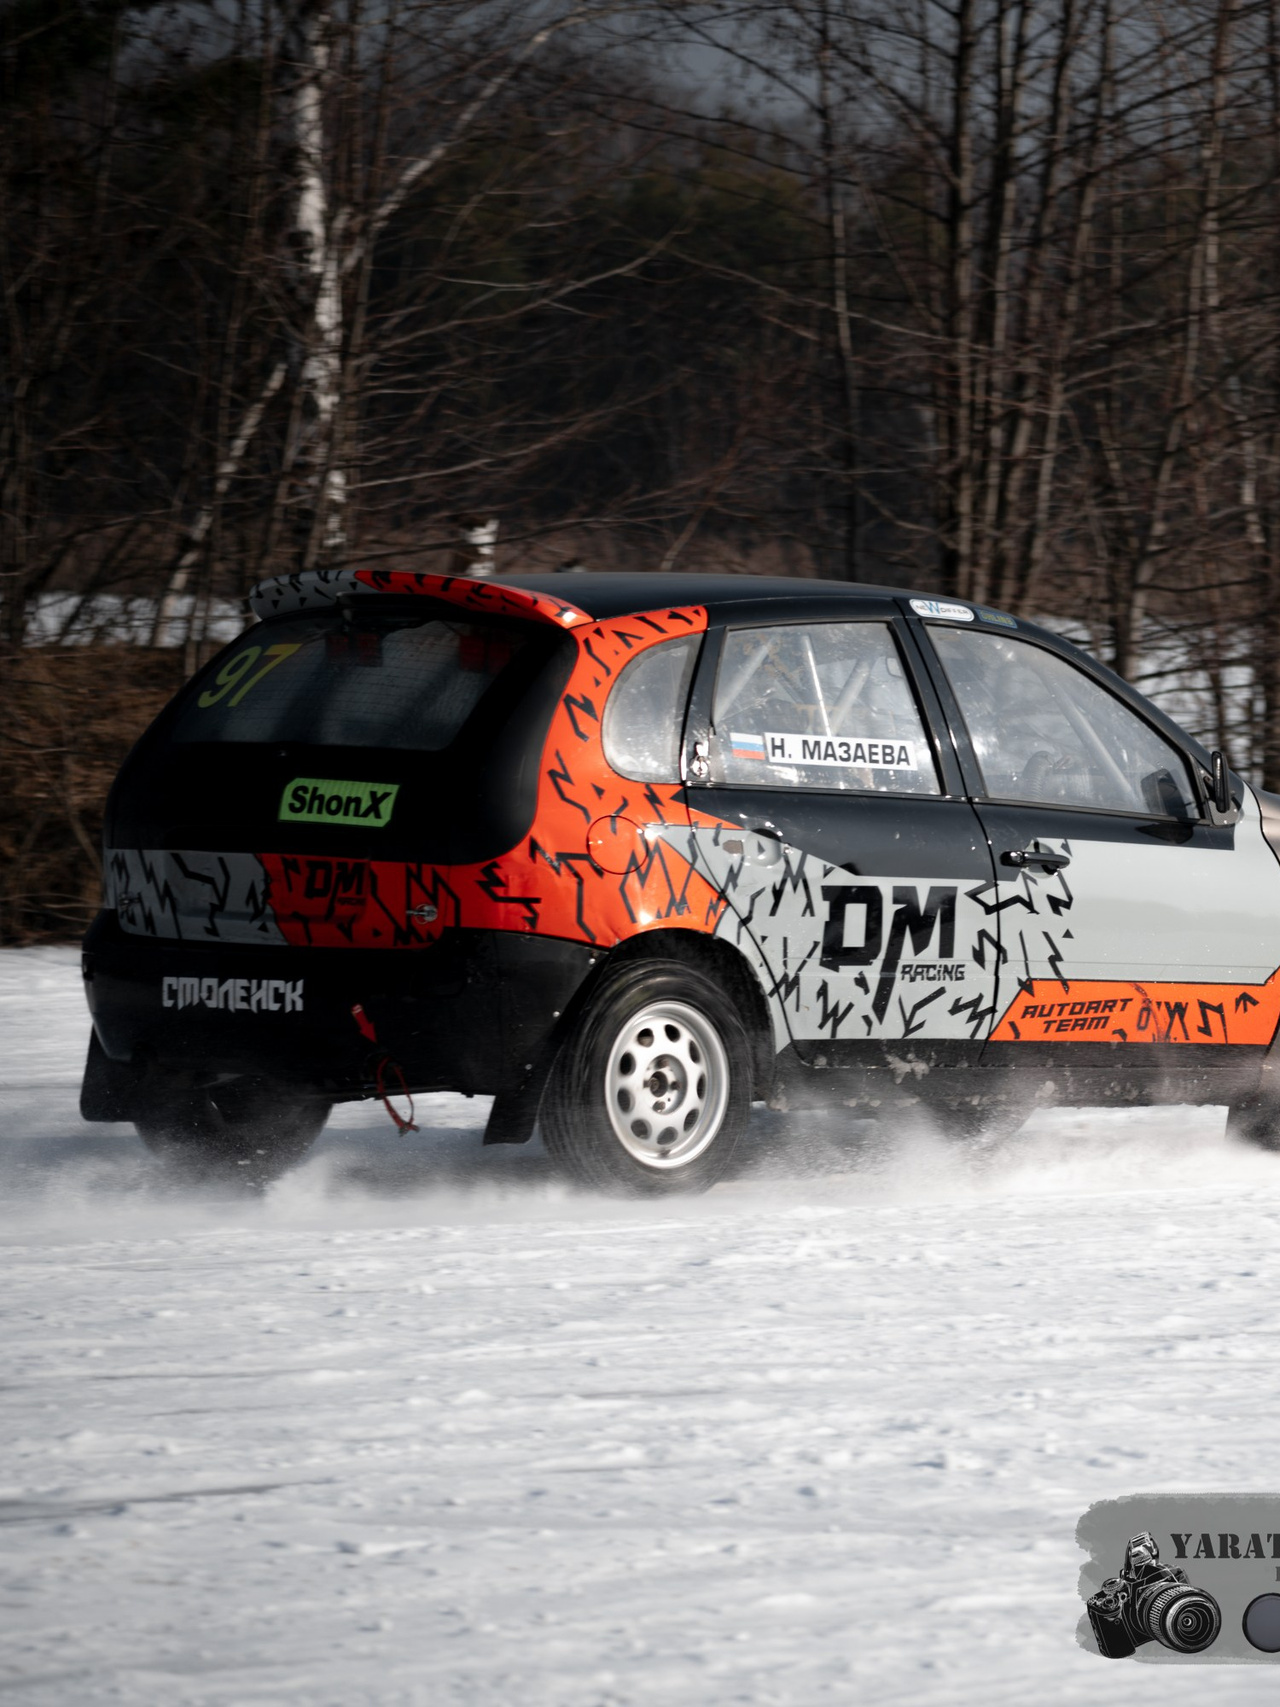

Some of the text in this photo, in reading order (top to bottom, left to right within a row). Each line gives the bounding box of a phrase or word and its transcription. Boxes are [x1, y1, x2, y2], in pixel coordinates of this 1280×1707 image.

[197, 643, 303, 709] 97
[771, 737, 911, 766] Н. МАЗАЕВА
[288, 785, 393, 820] ShonX
[819, 885, 958, 1025] DM
[1021, 998, 1134, 1019] AUTOART
[1043, 1015, 1111, 1034] TEAM
